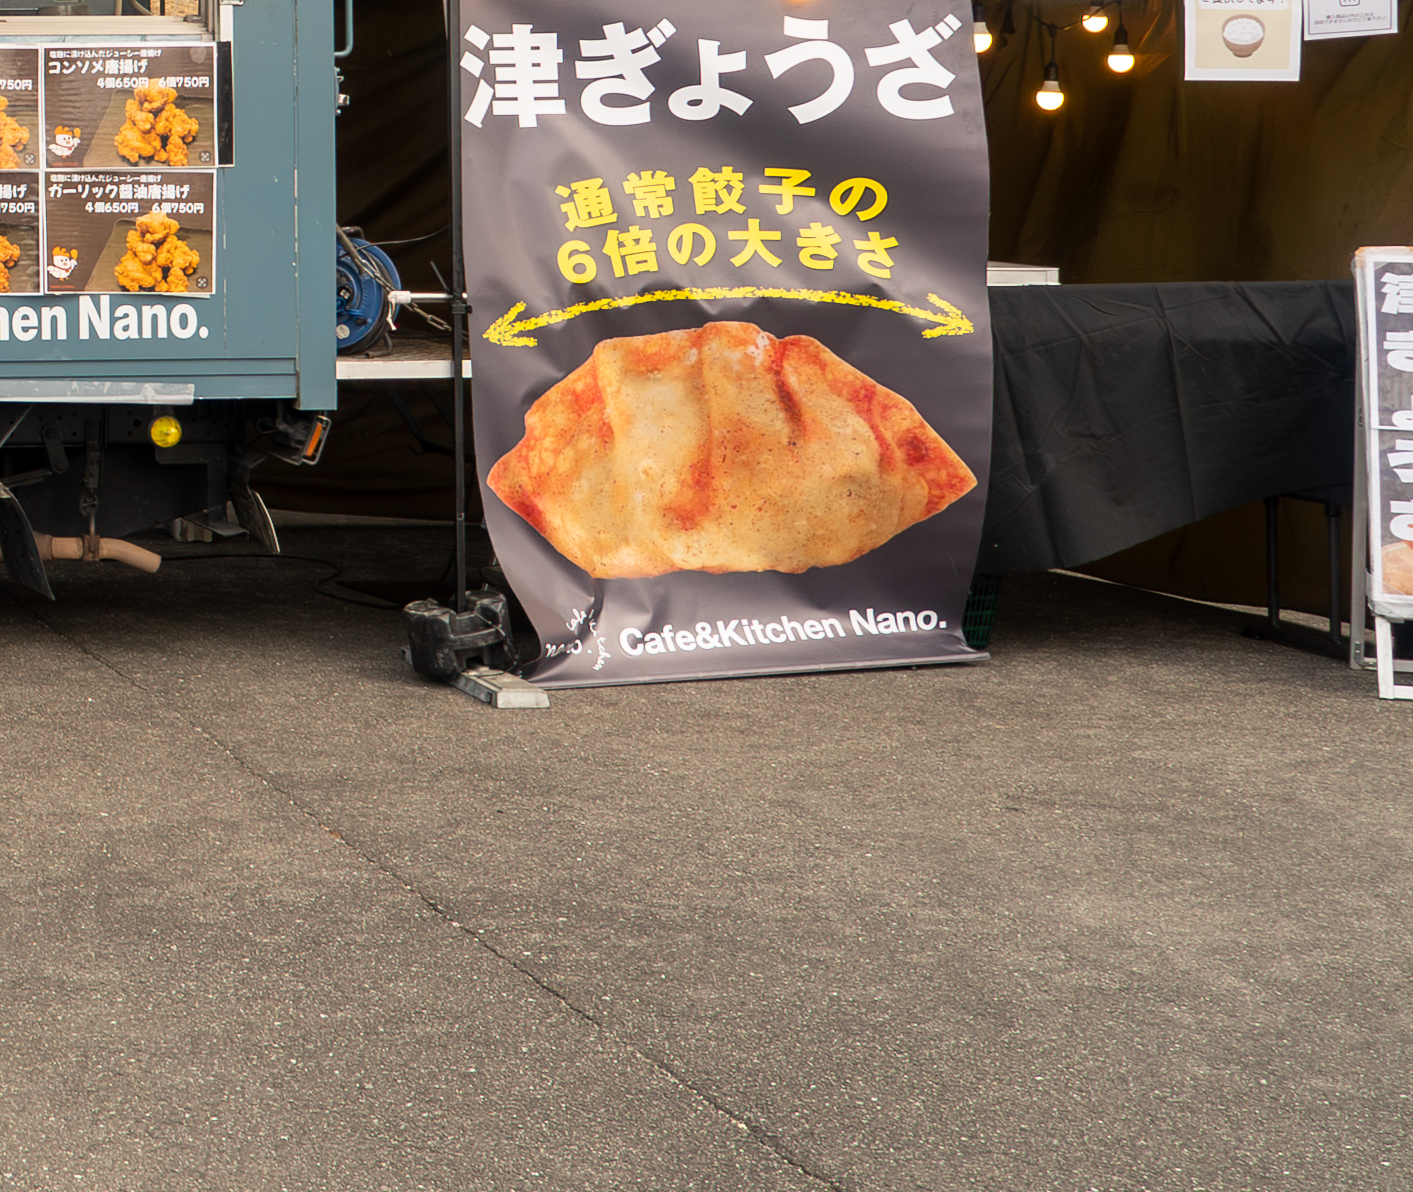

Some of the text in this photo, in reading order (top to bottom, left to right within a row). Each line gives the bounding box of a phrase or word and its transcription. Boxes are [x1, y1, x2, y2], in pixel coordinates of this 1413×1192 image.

[48, 59, 148, 74] コンソメ唐揚げ
[460, 13, 962, 128] 津ぎょうざ
[48, 184, 190, 199] ガーリック醤油唐揚げ
[555, 166, 888, 231] 通常餃子の
[557, 218, 898, 284] 6倍の大きさ
[78, 294, 209, 340] Nano.
[619, 609, 946, 656] Cafe&Kitchen Nano.
